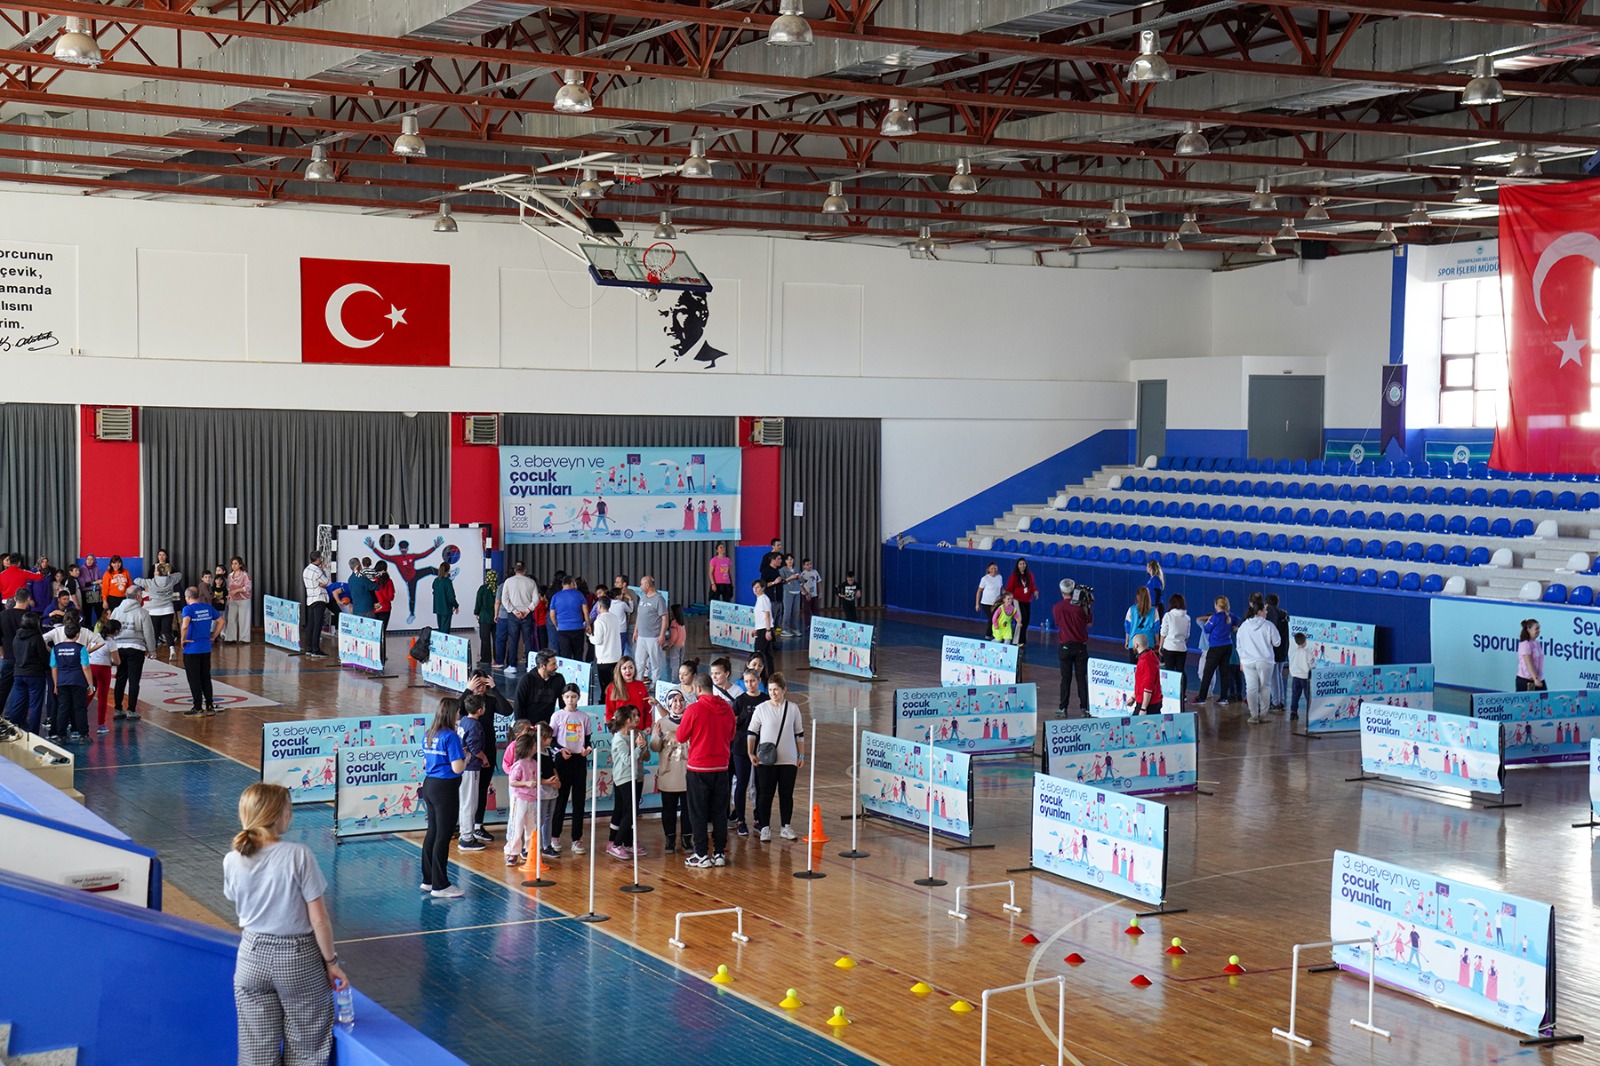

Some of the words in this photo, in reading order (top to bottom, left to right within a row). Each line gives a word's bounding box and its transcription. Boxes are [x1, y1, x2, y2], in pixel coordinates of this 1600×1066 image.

[0, 266, 42, 279] çevik,
[1438, 268, 1455, 276] SPOR
[1456, 264, 1477, 276] İŞLERİ
[510, 454, 521, 468] 3.
[524, 454, 584, 470] ebeveyn
[587, 457, 604, 468] ve
[510, 469, 557, 484] çocuk
[510, 482, 572, 498] oyunları
[514, 506, 525, 516] 18
[1324, 670, 1354, 680] ebeveyn
[1356, 670, 1365, 678] ve
[1316, 679, 1339, 688] çocuk
[911, 691, 946, 700] ebeveyn
[1316, 687, 1348, 696] oyunları
[902, 700, 930, 709] çocuk
[1486, 696, 1520, 705] ebeveyn
[902, 708, 938, 718] oyunları
[1477, 705, 1504, 715] çocuk
[1060, 722, 1098, 733] ebeveyn
[1099, 721, 1110, 729] ve
[1366, 717, 1391, 726] çocuk
[272, 727, 281, 737] 3.
[284, 725, 330, 736] ebeveyn
[1367, 725, 1400, 736] oyunları
[272, 736, 309, 748] çocuk
[1052, 733, 1081, 746] çocuk
[272, 746, 320, 759] oyunları
[346, 752, 356, 762] 3.
[358, 750, 408, 761] ebeveyn
[411, 748, 424, 758] ve
[866, 748, 886, 759] çocuk
[1052, 743, 1090, 756] oyunları
[346, 761, 386, 775] çocuk
[866, 757, 892, 770] oyunları
[346, 772, 398, 786] oyunları
[1040, 793, 1063, 807] çocuk
[1040, 805, 1070, 821] oyunları
[1342, 855, 1352, 870] 3.
[1354, 860, 1403, 886] ebeveyn
[1405, 877, 1420, 890] ve
[1342, 872, 1380, 893] çocuk
[1341, 887, 1391, 911] oyunları
